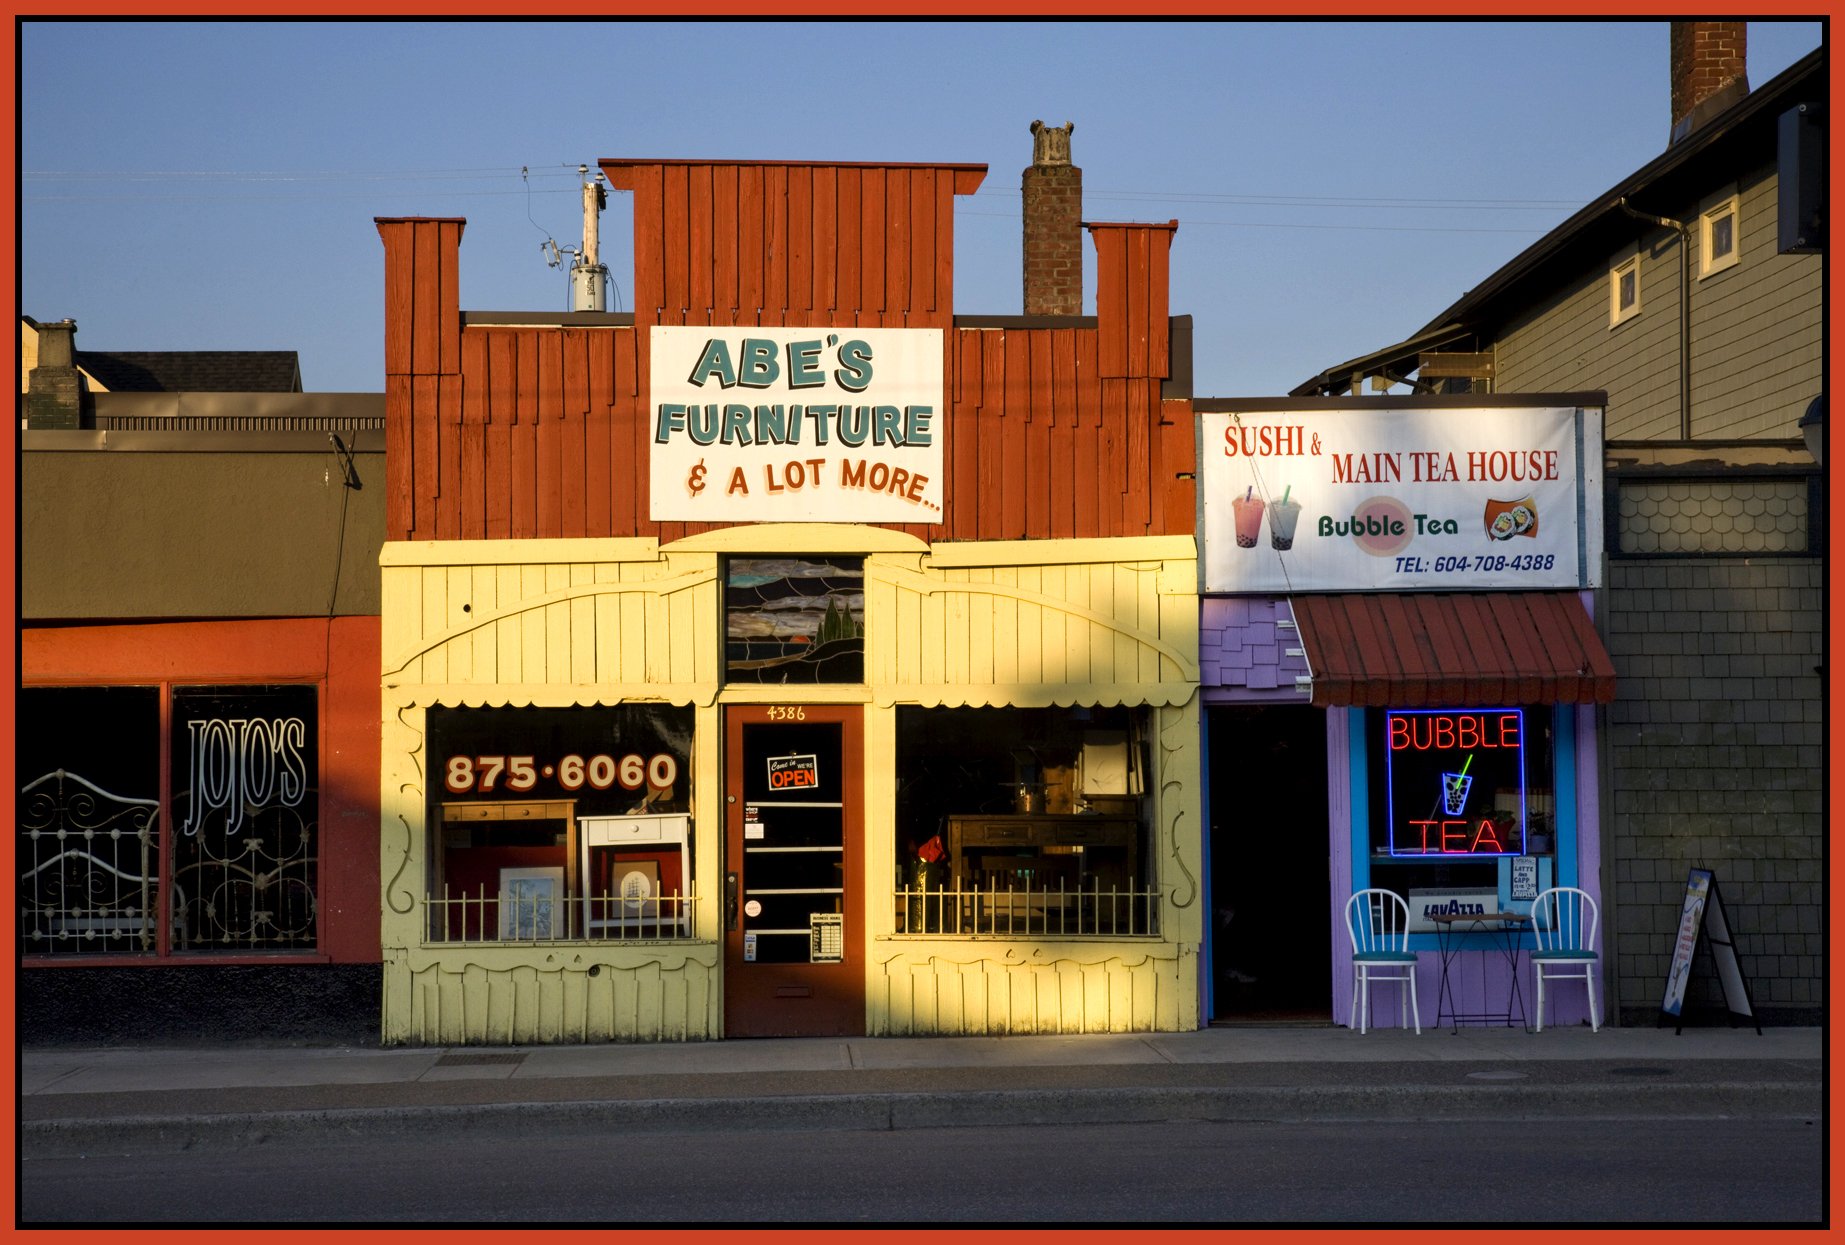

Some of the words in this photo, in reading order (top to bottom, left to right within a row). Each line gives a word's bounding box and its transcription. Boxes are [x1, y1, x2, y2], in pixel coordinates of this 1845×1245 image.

[688, 334, 873, 393] ABE'S
[655, 404, 933, 448] FURNITURE
[1224, 425, 1305, 457] SUSHI
[1311, 432, 1322, 456] &
[1332, 452, 1401, 484] MAIN
[1409, 451, 1460, 483] TEA
[1467, 450, 1559, 482] HOUSE
[687, 458, 708, 497] &
[727, 467, 749, 496] A
[764, 459, 826, 495] LOT
[840, 459, 941, 512] MORE...
[1318, 515, 1405, 537] Bubble
[1413, 514, 1458, 535] Tea
[1395, 557, 1429, 573] TEL:
[1434, 555, 1555, 573] 604-708-4388
[767, 706, 805, 720] 4386
[1390, 716, 1519, 749] BUBBLE
[184, 717, 306, 836] JOJO'S
[771, 761, 788, 770] Come
[771, 769, 815, 788] OPEN
[1409, 820, 1502, 854] TEA
[1423, 899, 1485, 917] LAVAZZA
